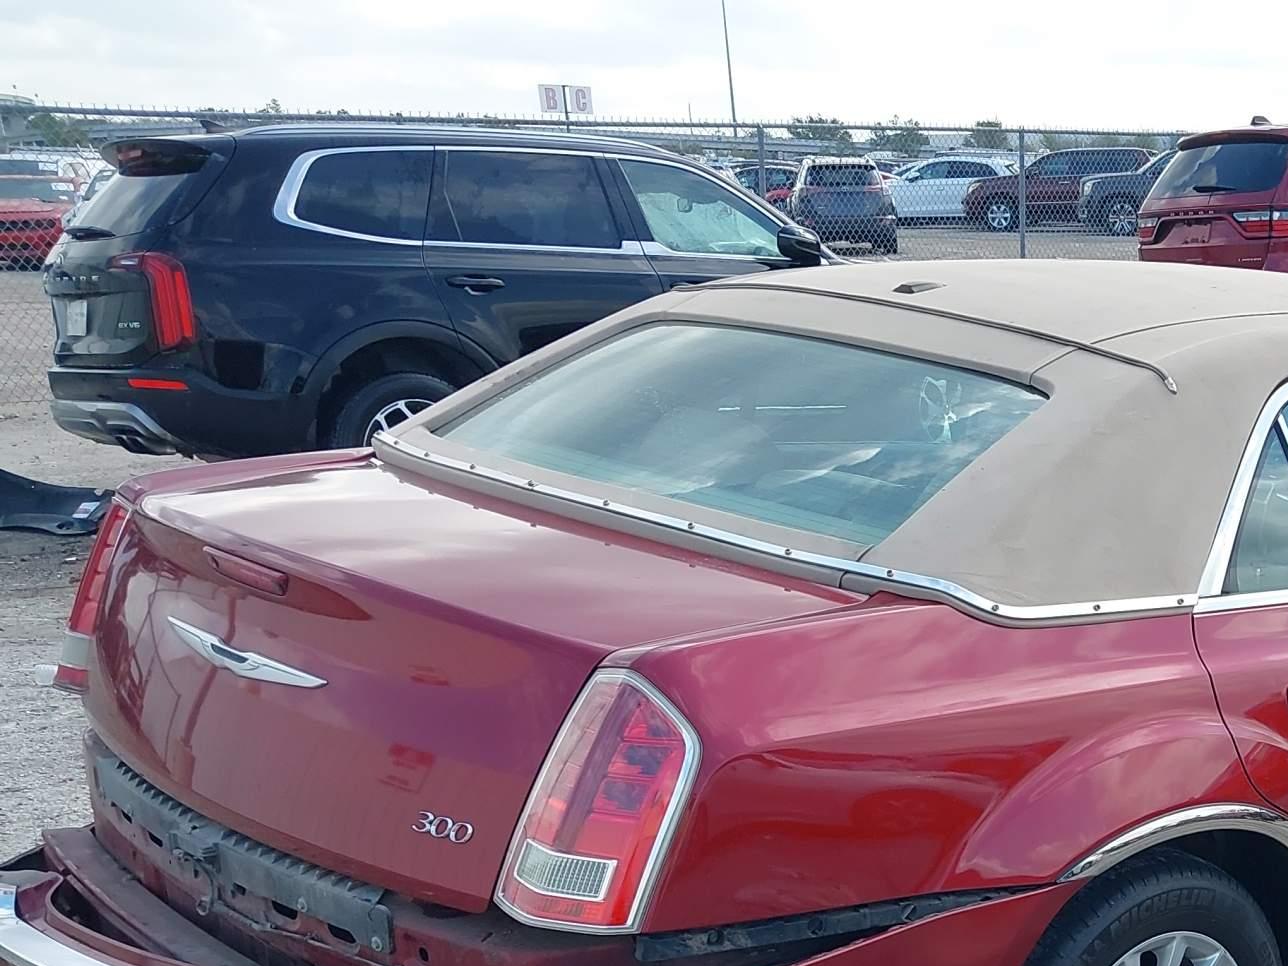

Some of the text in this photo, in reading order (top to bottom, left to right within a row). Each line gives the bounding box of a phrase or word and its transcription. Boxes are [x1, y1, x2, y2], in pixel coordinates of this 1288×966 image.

[544, 87, 558, 110] B
[575, 88, 588, 112] C
[411, 810, 474, 843] 300
[1110, 888, 1217, 939] MICHELIN
